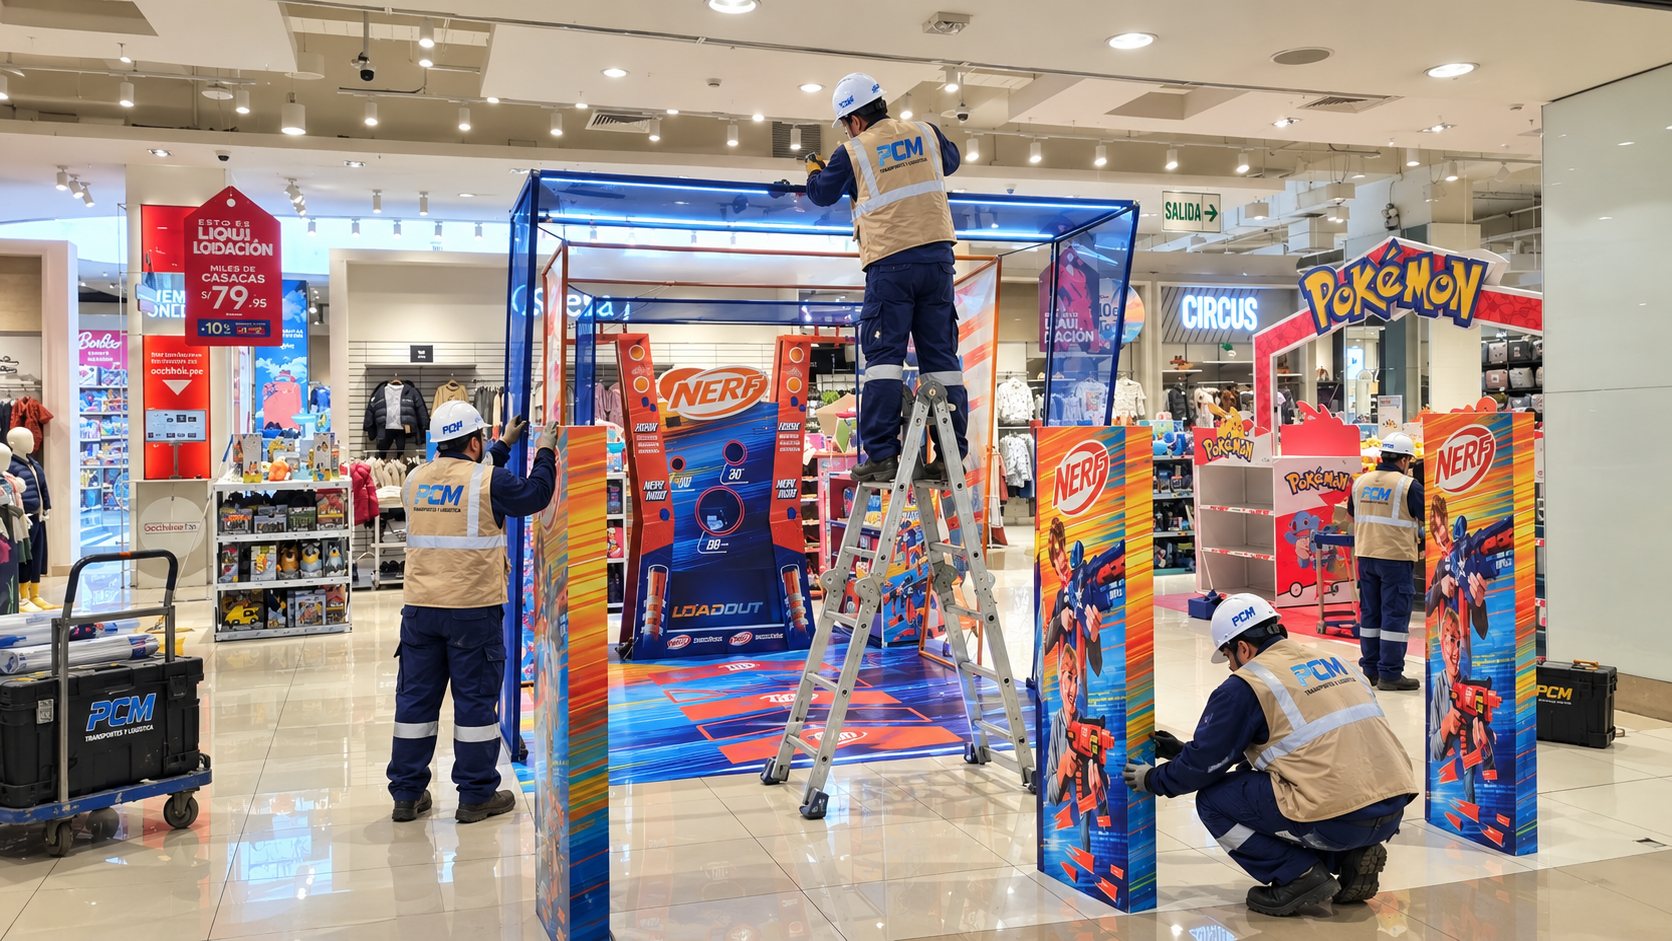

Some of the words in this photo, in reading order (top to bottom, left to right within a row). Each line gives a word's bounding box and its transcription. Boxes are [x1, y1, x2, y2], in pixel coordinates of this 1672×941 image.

[876, 135, 924, 167] PCM
[1165, 201, 1202, 222] SALIDA
[201, 273, 266, 284] CASACAS
[210, 265, 241, 273] MILES
[1181, 294, 1259, 332] CIRCUS
[669, 372, 768, 412] NERF
[1435, 433, 1495, 489] NERF
[1053, 448, 1109, 508] NERF
[414, 484, 465, 506] PCM
[672, 601, 763, 619] LOADOUT
[1231, 605, 1256, 627] PCM
[1289, 656, 1349, 687] PCM
[1536, 684, 1574, 701] PCM
[85, 692, 157, 732] PCM
